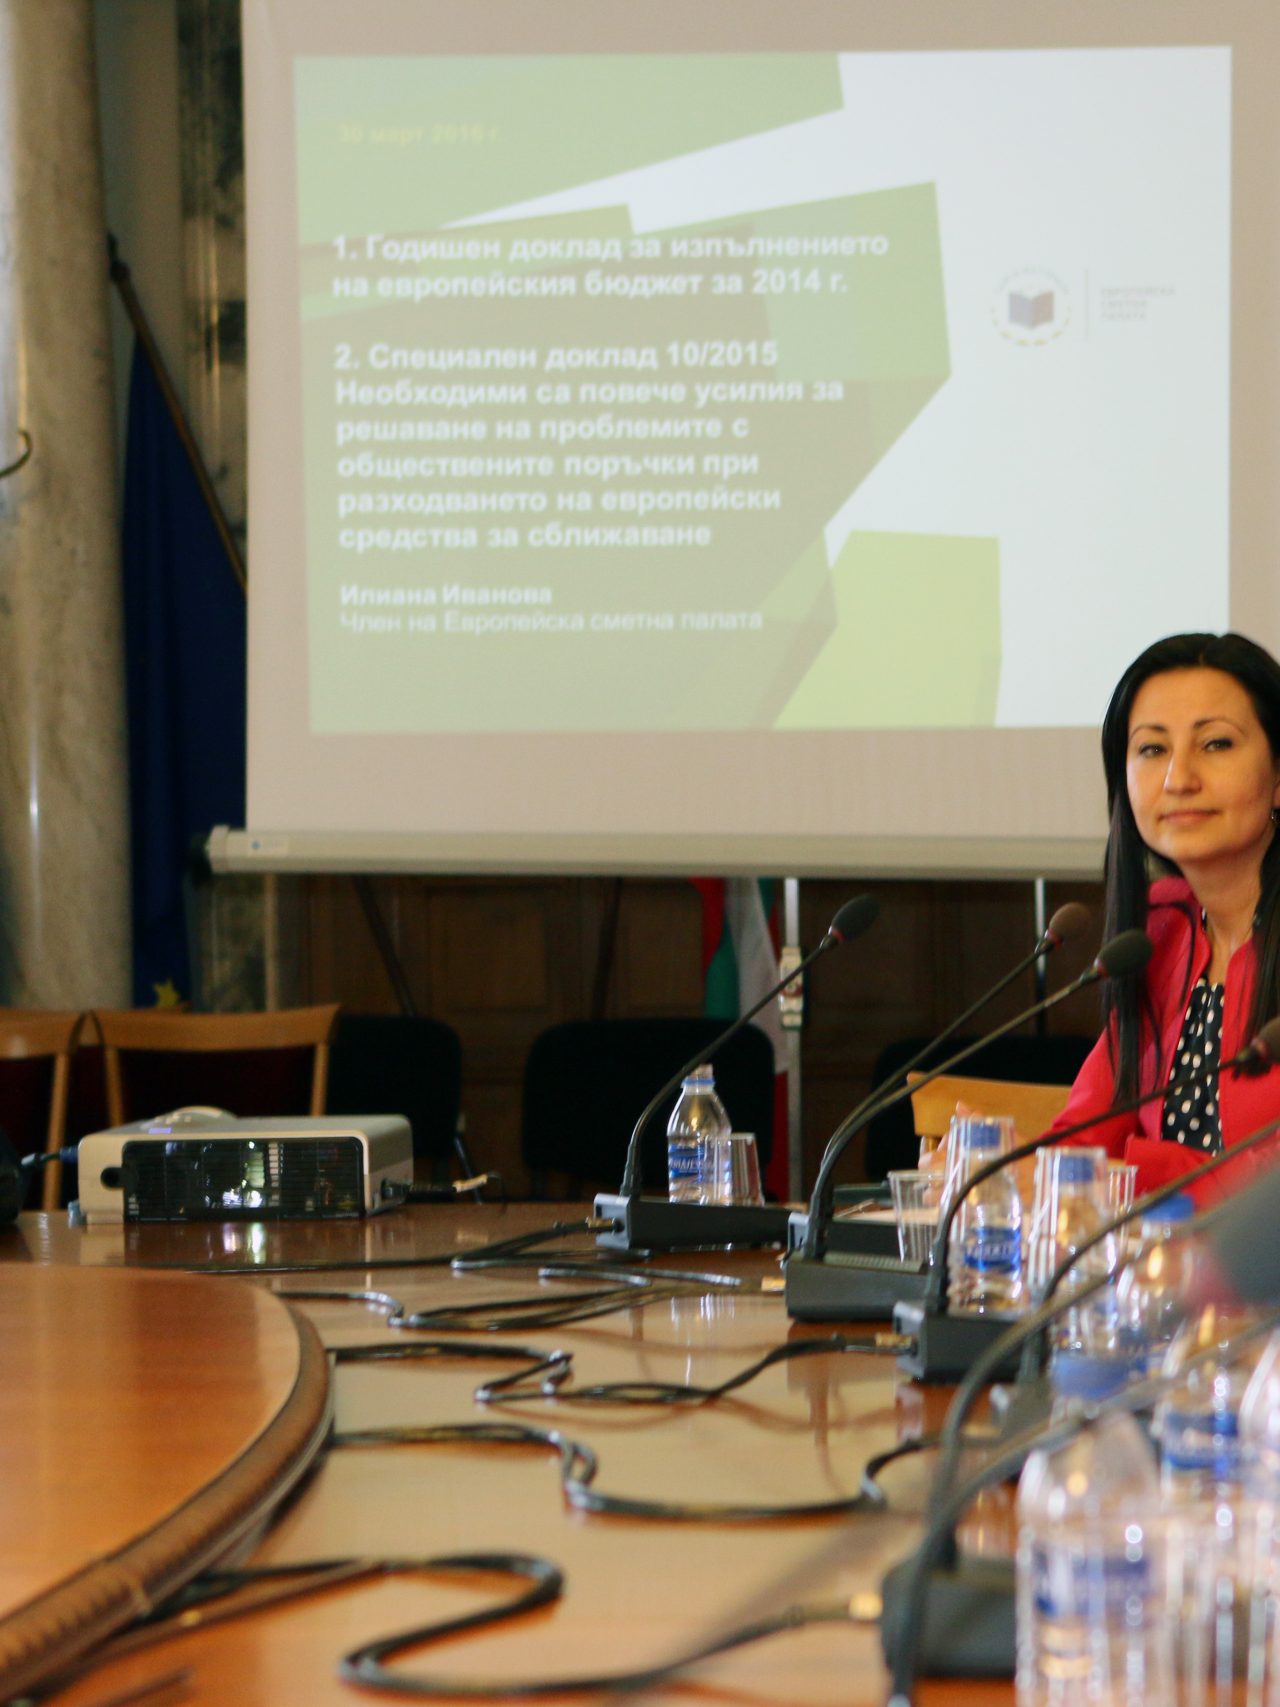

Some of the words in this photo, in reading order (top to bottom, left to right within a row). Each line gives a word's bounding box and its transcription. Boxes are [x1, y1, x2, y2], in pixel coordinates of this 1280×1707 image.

[333, 235, 358, 259] 1.
[366, 235, 500, 262] Годишен
[509, 237, 623, 262] доклад
[630, 239, 661, 258] за
[670, 235, 889, 258] изпълнението
[333, 277, 369, 297] на
[377, 270, 576, 300] европейския
[585, 269, 703, 298] бюджет
[711, 274, 743, 294] за
[752, 268, 822, 293] 2014
[831, 273, 848, 293] г.
[335, 344, 360, 369] 2.
[368, 344, 536, 372] Специален
[545, 346, 658, 371] доклад
[667, 340, 778, 367] 10/2015
[335, 380, 527, 408] Необходими
[536, 383, 571, 404] са
[579, 382, 686, 403] повече
[695, 381, 804, 408] усилия
[812, 380, 844, 400] за
[337, 419, 487, 446] решаване
[496, 419, 531, 440] на
[539, 413, 722, 444] проблемите
[732, 417, 749, 438] с
[337, 453, 555, 480] обществените
[564, 455, 695, 481] поръчки
[703, 453, 759, 480] при
[338, 491, 547, 518] разходването
[557, 490, 592, 511] на
[602, 484, 782, 516] европейски
[338, 527, 478, 554] средства
[488, 527, 518, 547] за
[528, 521, 711, 548] сближаване
[340, 584, 436, 606] Илиана
[443, 584, 552, 606] Иванова
[340, 611, 401, 632] Член
[408, 614, 436, 632] на
[444, 610, 585, 636] Европейска
[591, 612, 673, 631] сметна
[682, 612, 763, 630] палата
